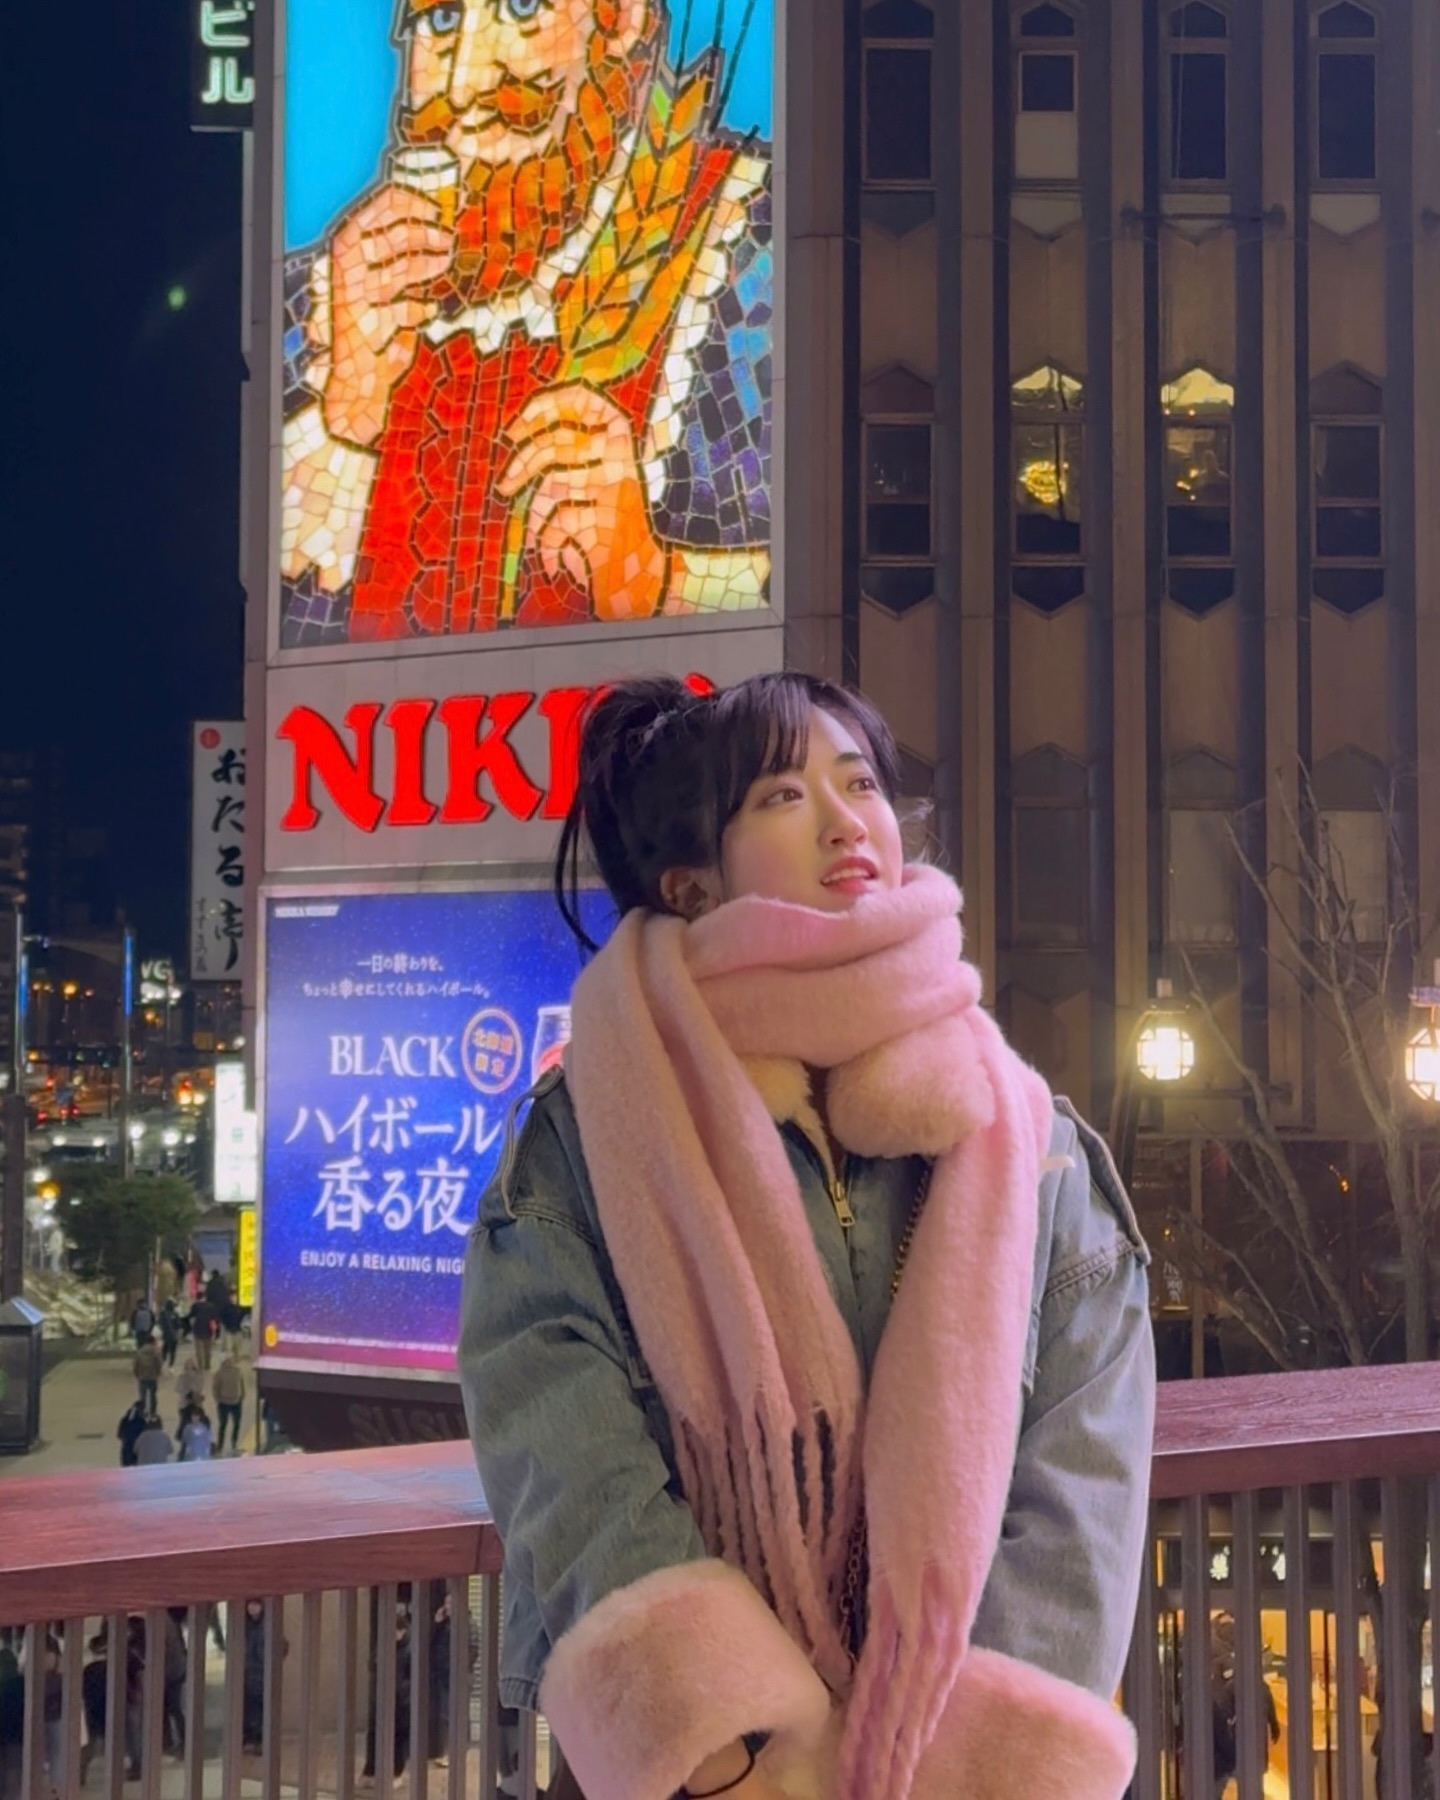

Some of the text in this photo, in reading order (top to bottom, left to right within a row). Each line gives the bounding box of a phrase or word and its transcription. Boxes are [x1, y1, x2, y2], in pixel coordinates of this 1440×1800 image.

[201, 0, 255, 104] ビル
[276, 672, 713, 832] NIK
[329, 1035, 456, 1078] BLACK
[284, 1094, 503, 1155] ハイボール
[312, 1156, 472, 1236] 香る夜
[300, 1250, 347, 1268] ENJOY
[348, 1253, 360, 1268] A
[363, 1253, 431, 1274] RELAXING
